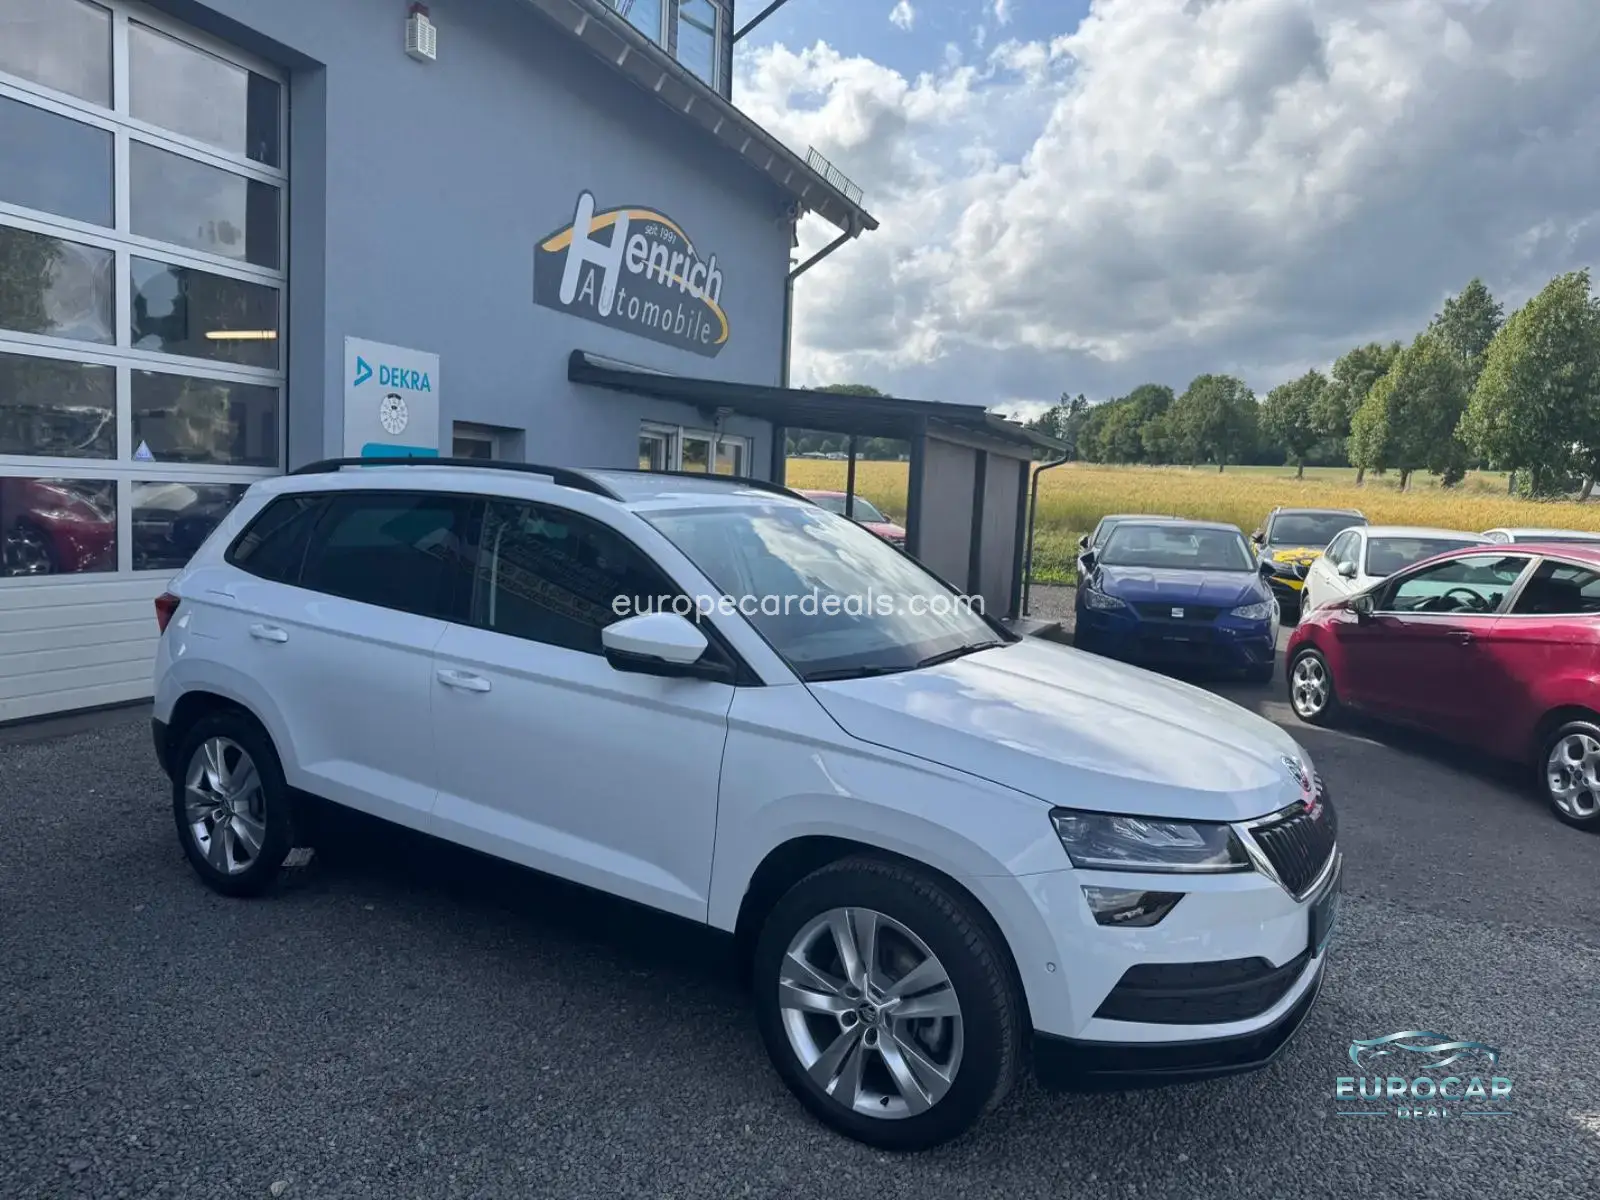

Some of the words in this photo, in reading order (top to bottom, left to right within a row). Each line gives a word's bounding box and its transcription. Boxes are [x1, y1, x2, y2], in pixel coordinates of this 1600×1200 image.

[660, 226, 677, 245] 1991
[559, 193, 722, 317] Henrich
[379, 364, 431, 393] DEKRA
